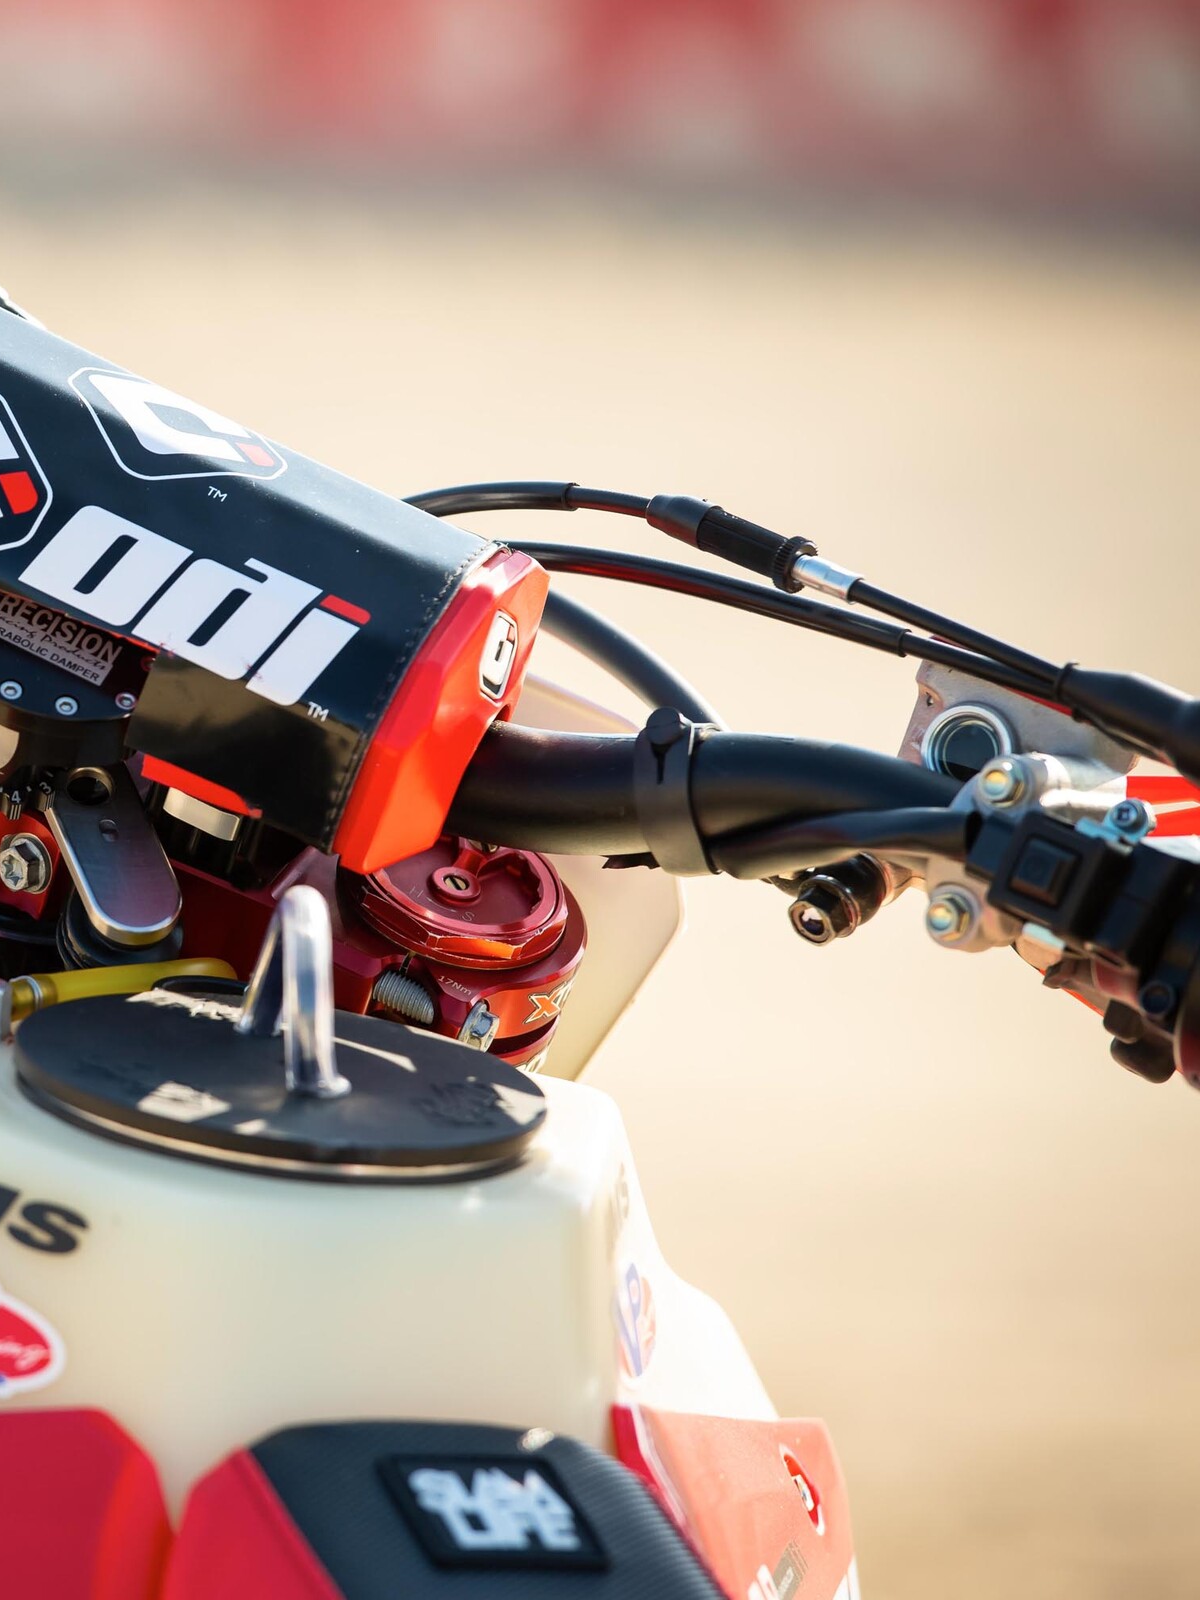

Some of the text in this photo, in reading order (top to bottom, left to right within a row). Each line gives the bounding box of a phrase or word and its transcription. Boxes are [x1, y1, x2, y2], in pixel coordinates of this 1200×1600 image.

[17, 504, 372, 706] odi
[49, 652, 100, 682] DAMPER
[10, 790, 22, 804] 4
[38, 781, 51, 795] 3
[437, 974, 472, 996] 17Nm
